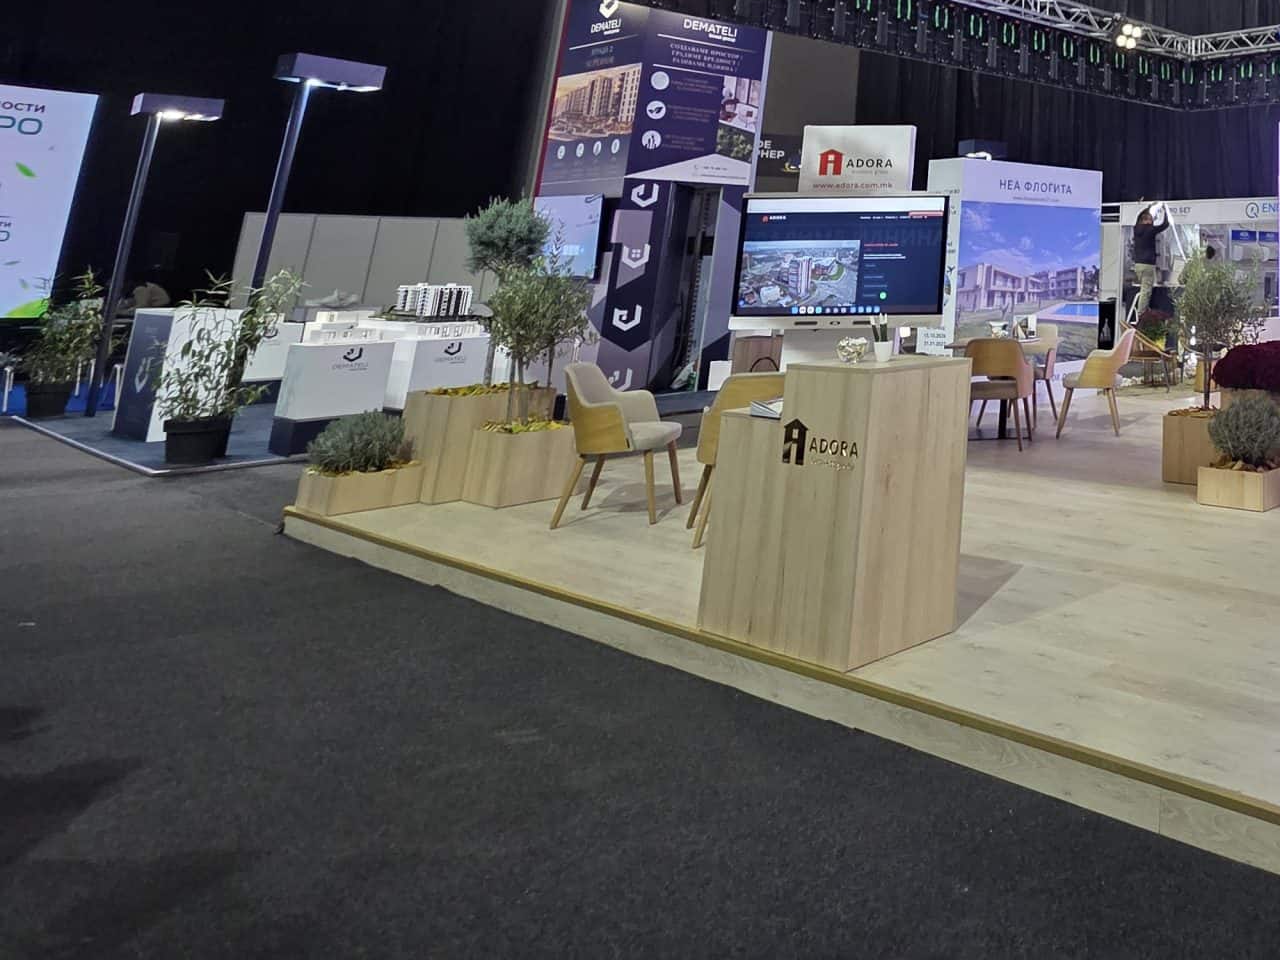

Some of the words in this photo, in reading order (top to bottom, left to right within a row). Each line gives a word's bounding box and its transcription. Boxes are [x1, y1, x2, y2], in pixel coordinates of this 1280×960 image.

[683, 18, 738, 37] DEMATELI
[0, 101, 45, 112] ОСТИ
[846, 158, 893, 168] ADORA
[999, 179, 1020, 191] НЕА
[1024, 182, 1072, 194] ФЛОГИТА
[809, 437, 858, 458] ADORA
